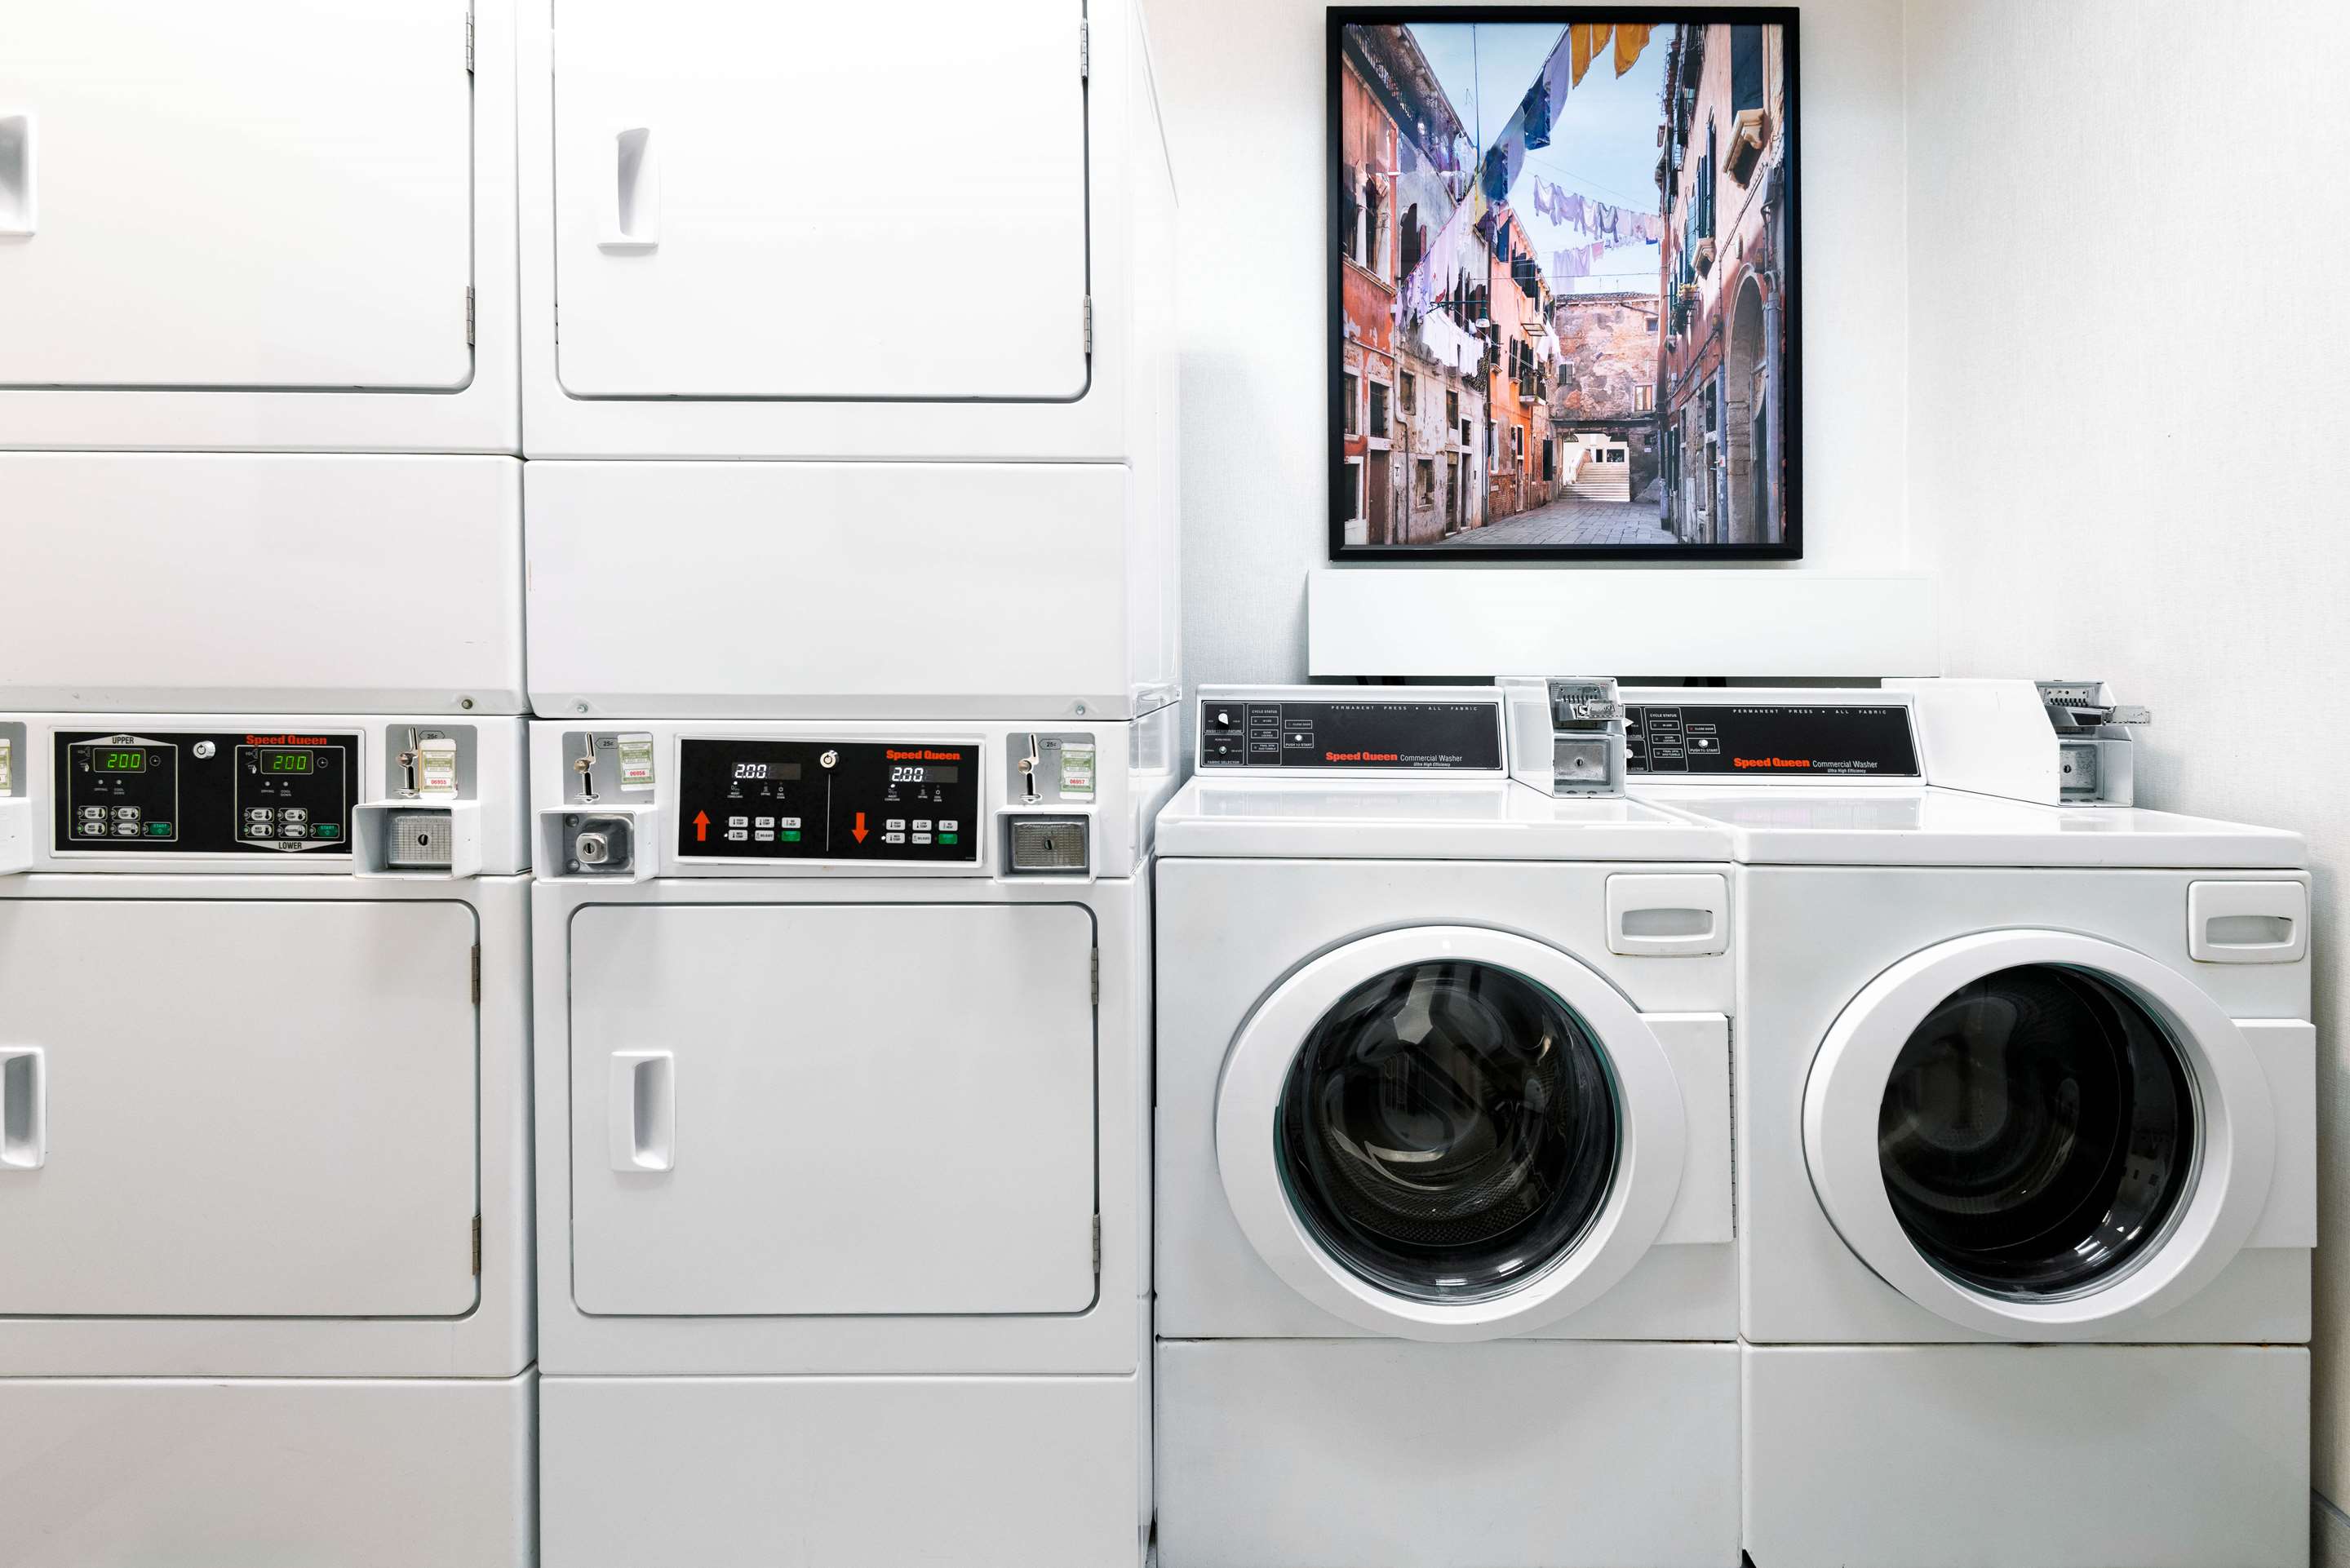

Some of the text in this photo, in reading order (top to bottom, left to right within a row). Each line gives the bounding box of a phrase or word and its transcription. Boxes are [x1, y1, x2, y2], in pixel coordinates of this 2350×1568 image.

[246, 735, 327, 747] Speed Queen
[886, 749, 960, 760] Speed Queen
[1325, 752, 1361, 762] Speed
[1362, 752, 1398, 761] Queen
[107, 754, 141, 768] 200
[273, 756, 307, 770] 200
[1733, 757, 1878, 768] Speed Queen Commercial Washer
